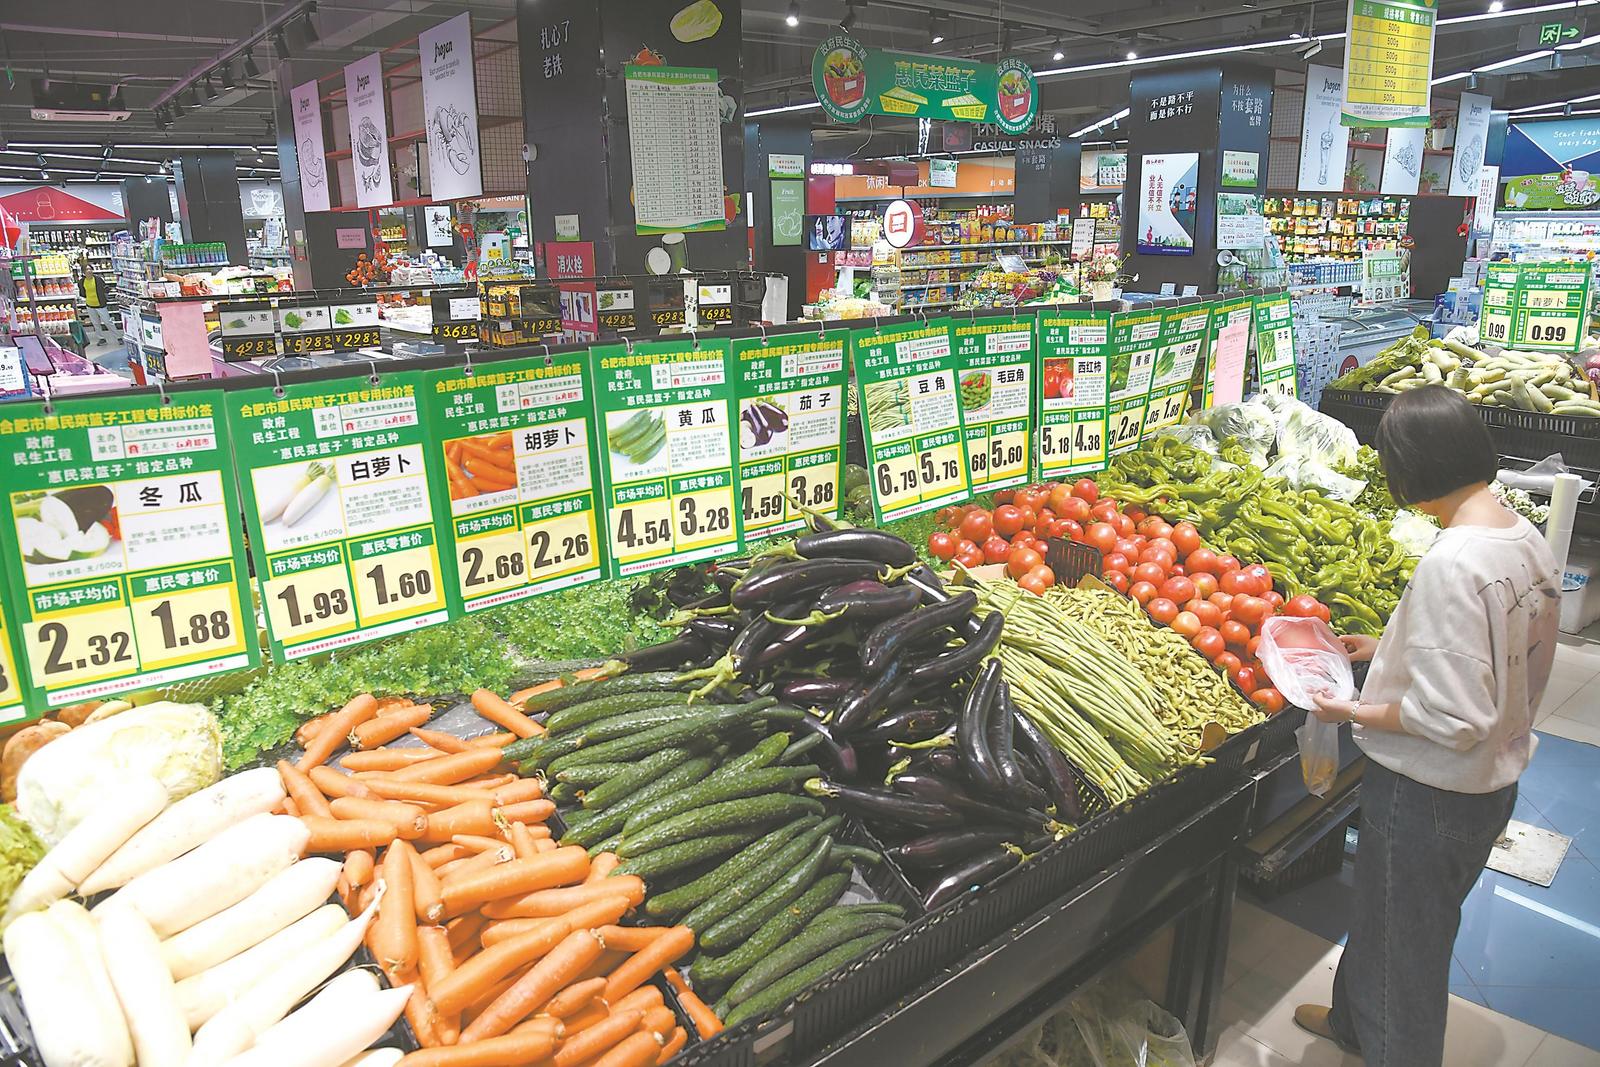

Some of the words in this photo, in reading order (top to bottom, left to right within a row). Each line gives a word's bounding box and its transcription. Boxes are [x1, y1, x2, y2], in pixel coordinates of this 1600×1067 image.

[541, 20, 570, 50] 扎心了
[1388, 22, 1400, 33] 500g
[1387, 36, 1399, 47] 500g
[1386, 51, 1397, 61] 500g
[542, 53, 564, 79] 老铁
[1385, 65, 1396, 75] 500g
[894, 61, 977, 93] 惠民菜篮子
[1384, 79, 1396, 89] 500g
[1233, 84, 1252, 96] 为什么
[1383, 93, 1395, 103] 500g
[1151, 91, 1195, 109] 不是路不平
[1232, 97, 1263, 114] 不按套路
[1149, 103, 1193, 121] 而是你不行
[1553, 130, 1576, 139] Start
[1582, 138, 1597, 146] day
[974, 141, 1014, 151] CASUAL
[1019, 138, 1061, 150] SNACKS
[1155, 174, 1164, 212] 人无信不立
[557, 255, 583, 274] 消火栓
[305, 310, 323, 318] 香菜
[356, 307, 372, 315] 生菜
[1488, 322, 1505, 339] 0.99
[1532, 325, 1566, 341] 0.99
[615, 369, 632, 380] 政府
[997, 368, 1024, 384] 毛豆角
[1078, 361, 1101, 373] 西红柿
[608, 379, 642, 392] 民生工程
[918, 376, 945, 394] 豆角
[240, 384, 414, 418] 合肥市惠民菜篮子工程专用标价签
[453, 393, 473, 405] 政府
[800, 392, 831, 411] 茄子
[1163, 398, 1180, 419] 1.88
[0, 404, 213, 434] 合肥市惠民菜篮子工程专用标价签
[444, 403, 486, 418] 民生工程
[679, 407, 716, 427] 黄瓜
[262, 416, 286, 429] 政府
[1118, 416, 1139, 441] 2.68
[26, 436, 55, 450] 政府
[252, 428, 300, 444] 民生工程
[525, 427, 576, 452] 胡萝卜
[1042, 427, 1069, 455] 5.18
[1075, 424, 1100, 451] 4.38
[14, 448, 72, 465] 民生工程
[794, 452, 832, 468] 惠民零售价
[992, 440, 1022, 468] 5.60
[351, 453, 411, 481] 白萝卜
[742, 462, 782, 478] 市场平均价
[920, 452, 958, 484] 5.76
[679, 474, 724, 491] 惠民零售价
[877, 463, 917, 496] 6.79
[139, 481, 202, 507] 冬瓜
[615, 485, 664, 501] 市场平均价
[791, 475, 833, 513] 3.88
[531, 498, 584, 520] 惠民零售价
[742, 486, 782, 520] 4.59
[457, 513, 513, 535] 市场平均价
[679, 497, 729, 536] 3.28
[617, 508, 671, 548] 4.54
[361, 533, 423, 557] 惠民零售价
[531, 530, 589, 571] 2.26
[272, 550, 340, 574] 市场平均价
[462, 547, 524, 588] 2.68
[145, 569, 220, 592] 惠民零售价
[366, 564, 432, 605] 1.60
[36, 585, 118, 610] 市场平均价
[278, 584, 348, 627] 1.93
[151, 600, 230, 649] 1.88
[38, 622, 132, 675] 2.32
